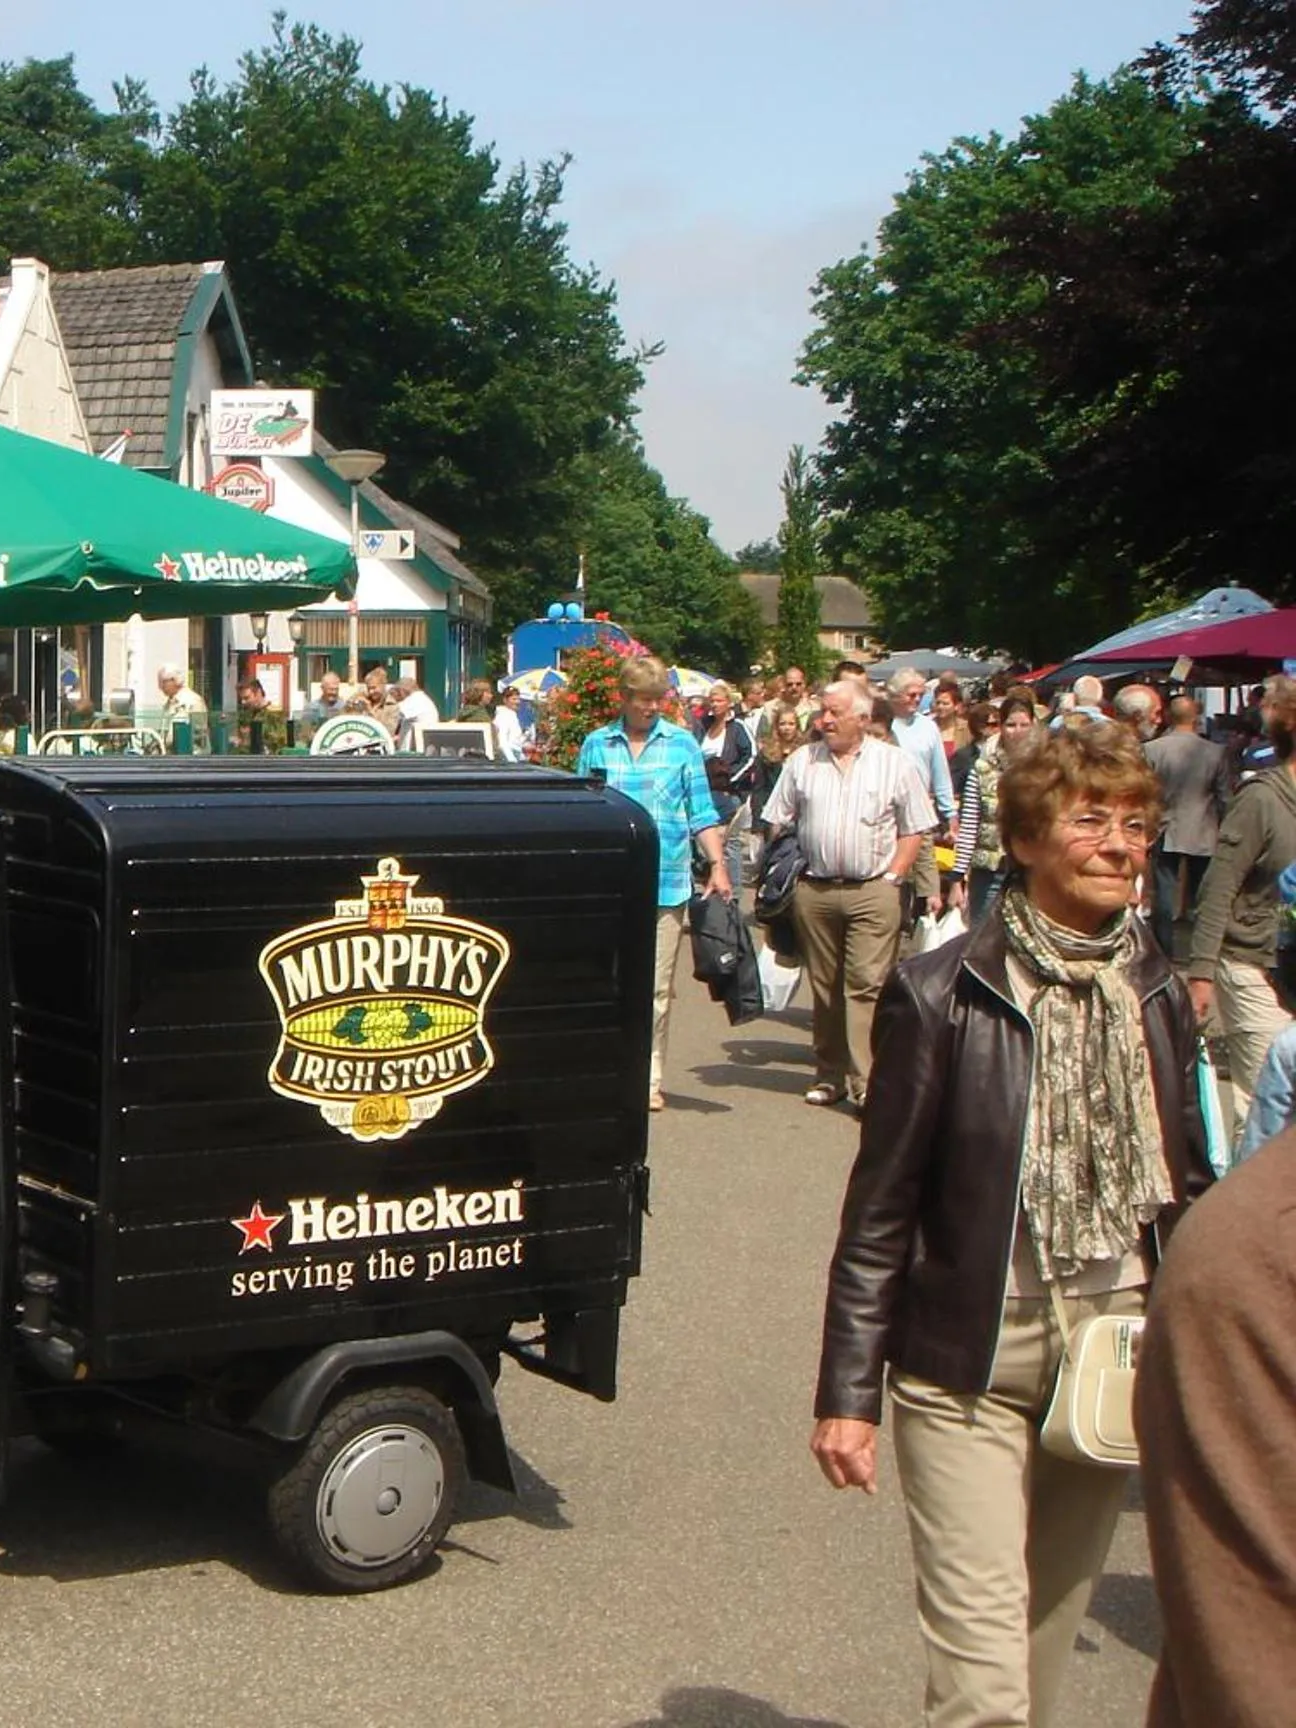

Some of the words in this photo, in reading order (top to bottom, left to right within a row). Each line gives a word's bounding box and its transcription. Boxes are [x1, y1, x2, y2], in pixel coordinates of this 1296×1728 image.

[218, 413, 253, 434] DE
[181, 551, 308, 581] Heineken
[278, 934, 488, 1008] MURPHY'S
[290, 1051, 375, 1092] IRISH
[379, 1041, 474, 1092] STOUT
[288, 1185, 524, 1245] Heineken
[231, 1256, 355, 1297] serving
[367, 1249, 416, 1282] the
[424, 1237, 523, 1282] planet
